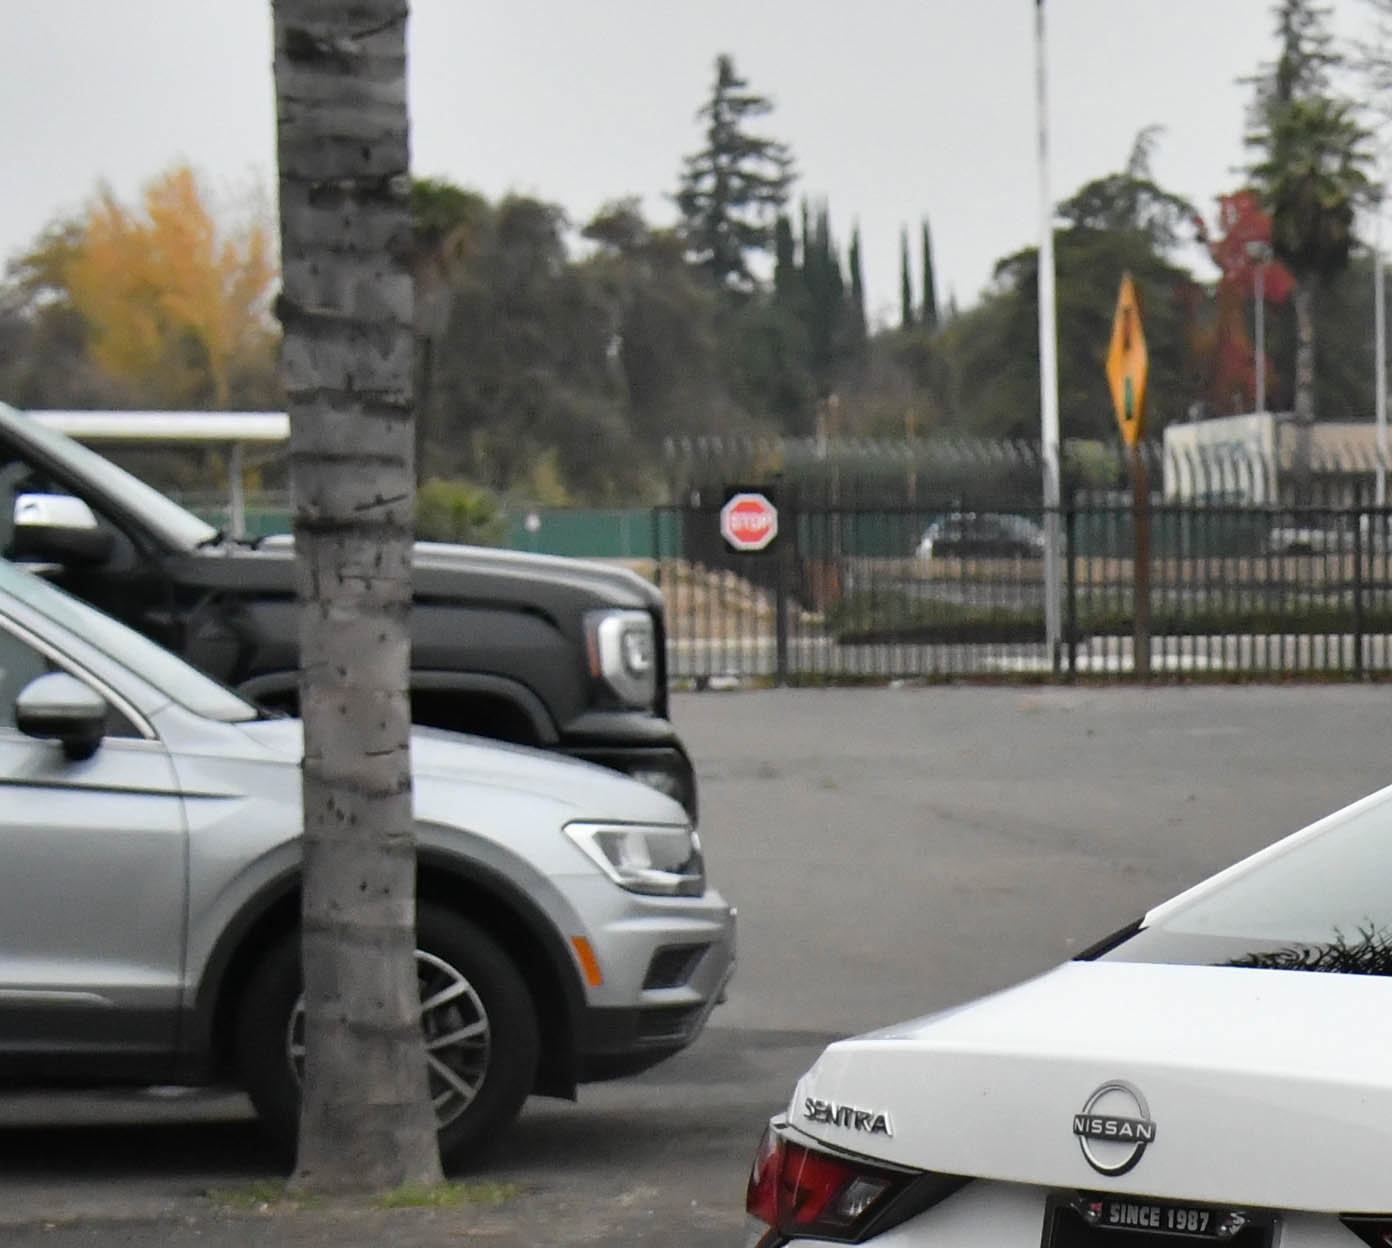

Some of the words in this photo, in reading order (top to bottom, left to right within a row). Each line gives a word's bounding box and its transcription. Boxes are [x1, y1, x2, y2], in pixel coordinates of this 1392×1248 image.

[729, 512, 772, 529] STOP
[804, 1098, 894, 1137] SENTRA
[1074, 1115, 1154, 1141] NISSAN
[1110, 1203, 1160, 1228] SINCE
[1167, 1208, 1210, 1231] 1987
